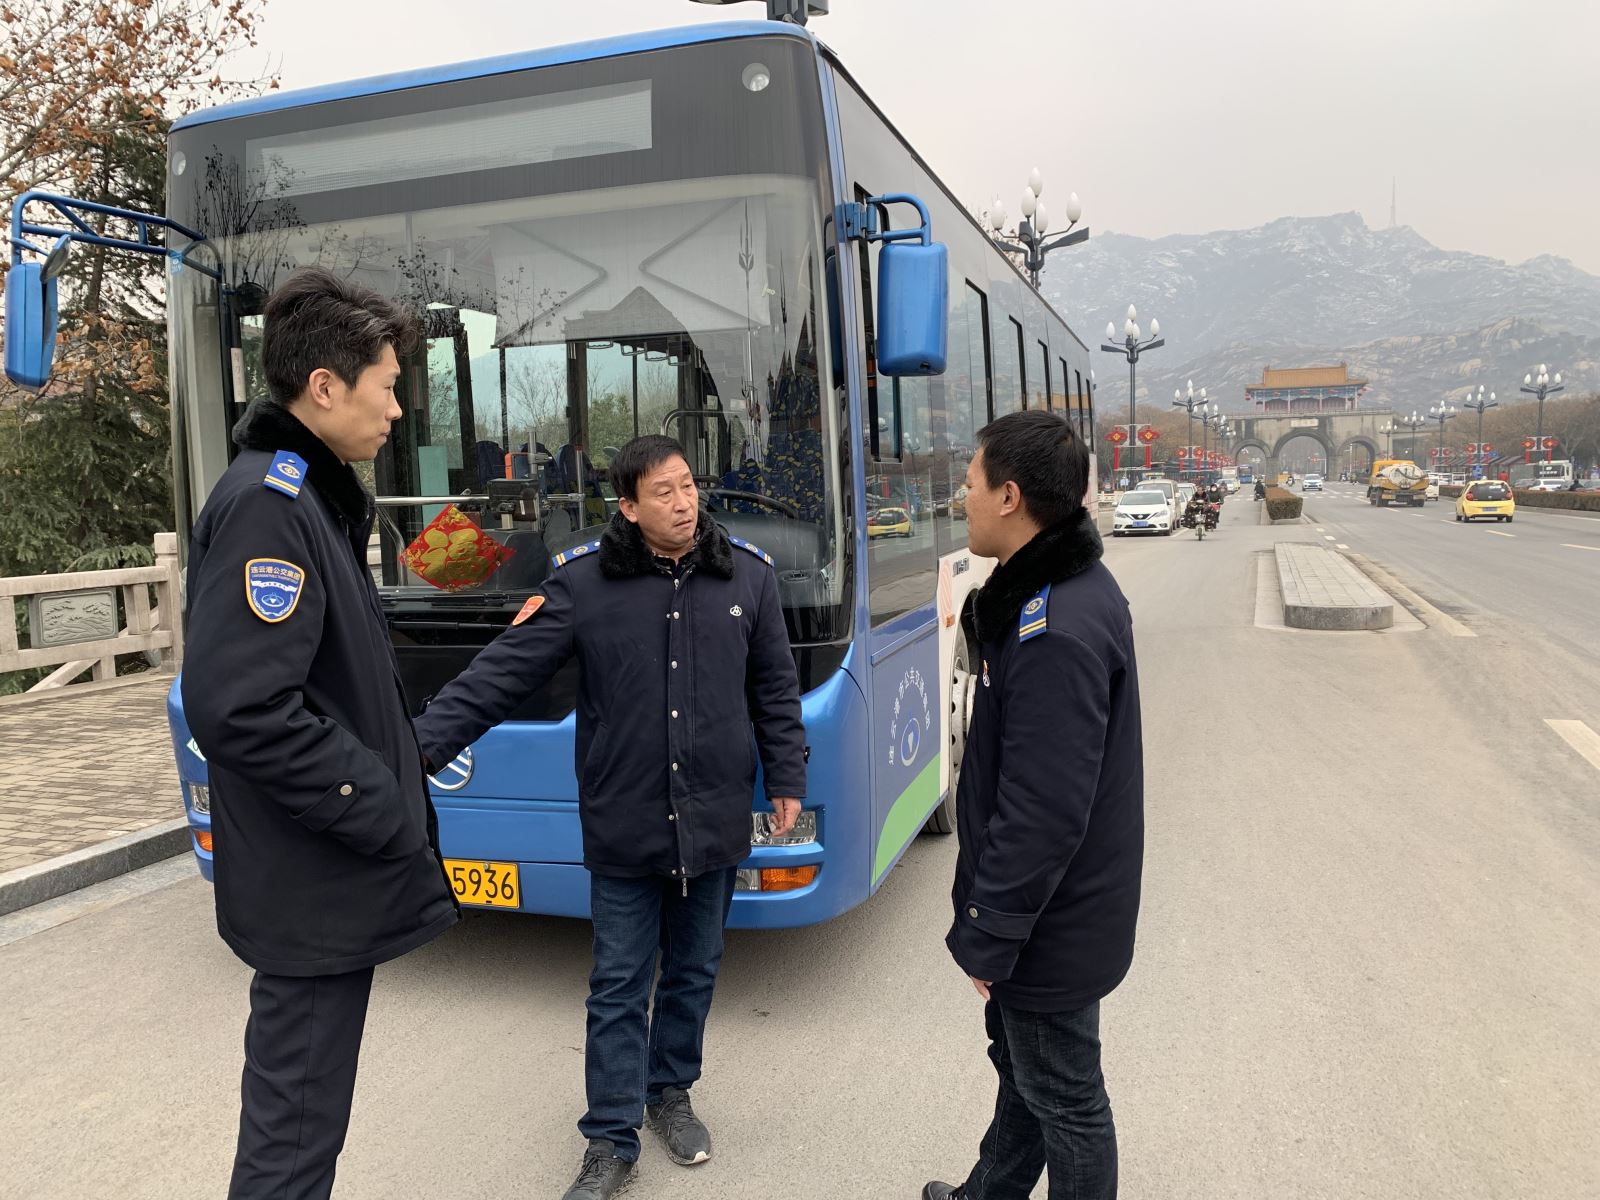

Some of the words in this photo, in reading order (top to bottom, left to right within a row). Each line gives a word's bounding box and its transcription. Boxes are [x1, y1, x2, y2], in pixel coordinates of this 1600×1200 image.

[420, 528, 489, 584] 福
[251, 566, 301, 580] 连云港公交集团
[453, 867, 514, 900] 5936
